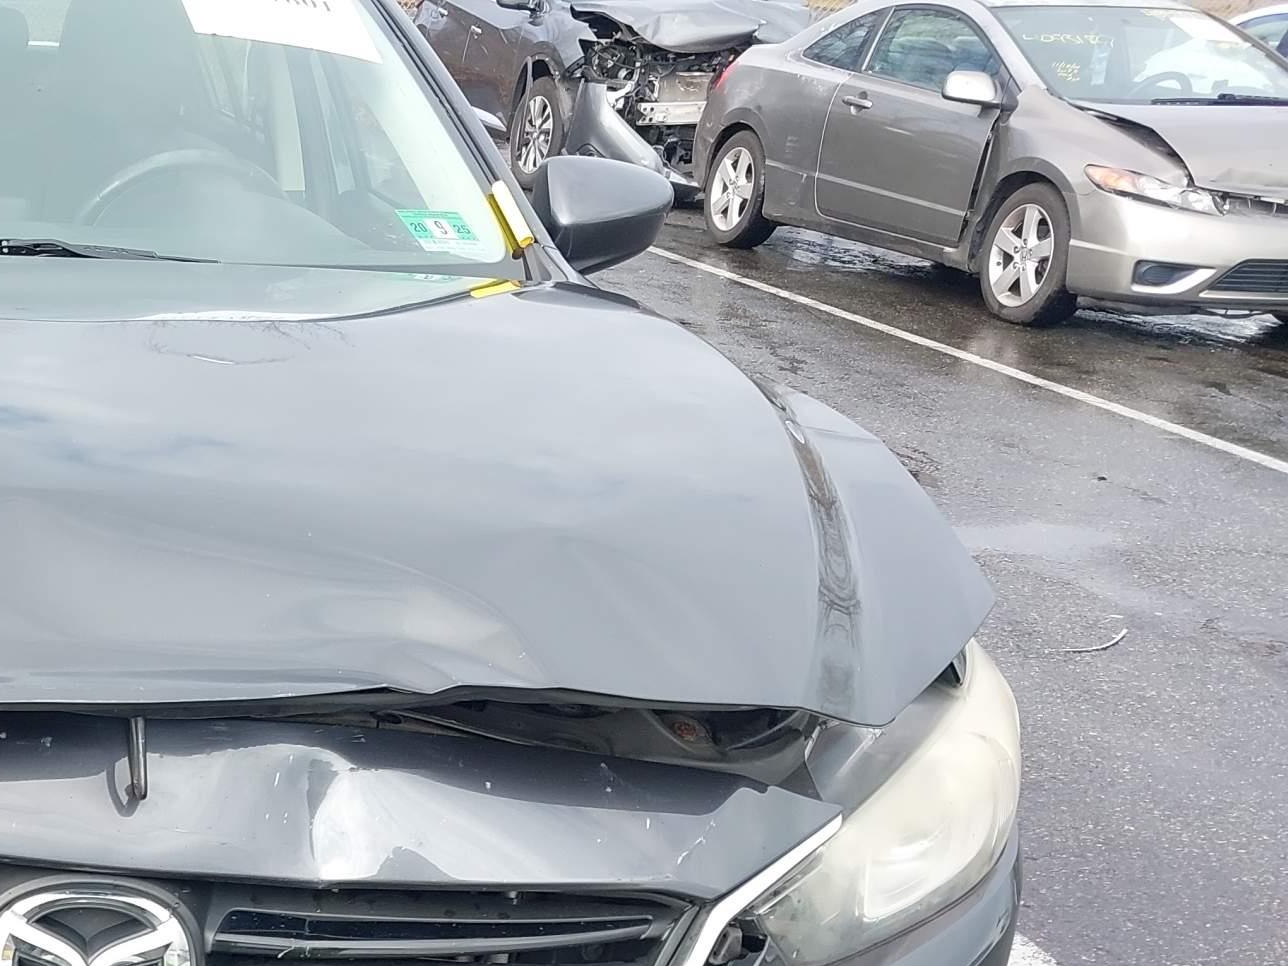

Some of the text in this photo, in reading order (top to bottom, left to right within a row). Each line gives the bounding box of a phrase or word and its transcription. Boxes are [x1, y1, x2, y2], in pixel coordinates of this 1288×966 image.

[410, 220, 471, 235] 20 9 25
